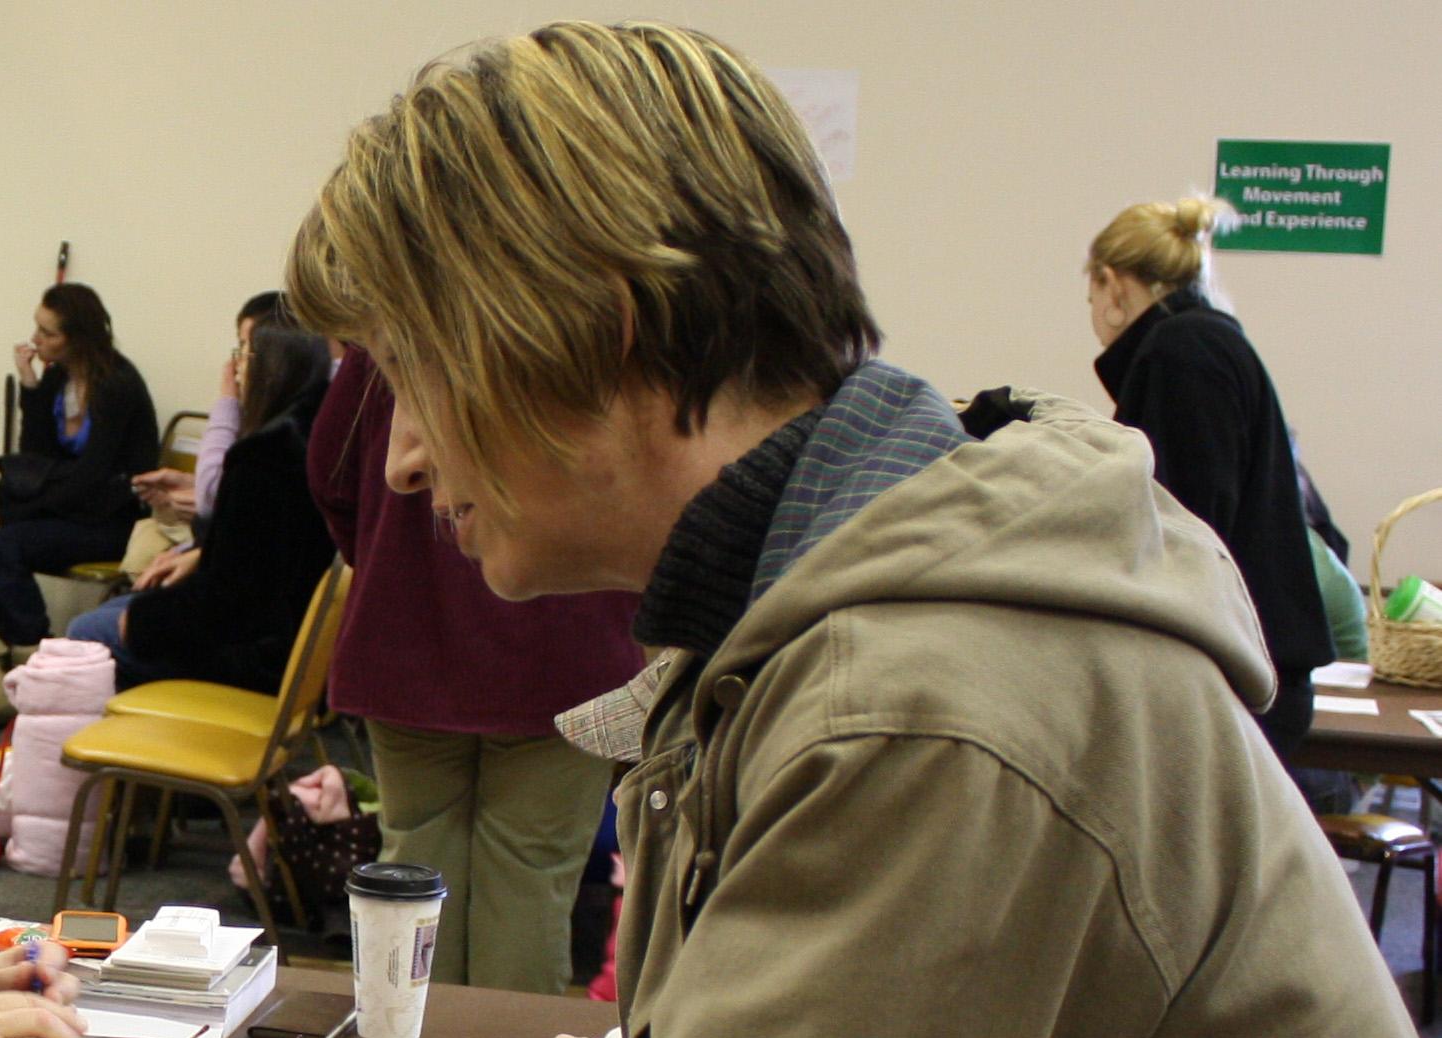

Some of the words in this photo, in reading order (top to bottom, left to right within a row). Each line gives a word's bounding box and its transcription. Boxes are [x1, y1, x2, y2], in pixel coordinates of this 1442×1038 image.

[1219, 162, 1302, 184] Learning
[1305, 164, 1384, 186] Through
[1242, 186, 1342, 205] Movement
[1265, 210, 1368, 231] Experience
